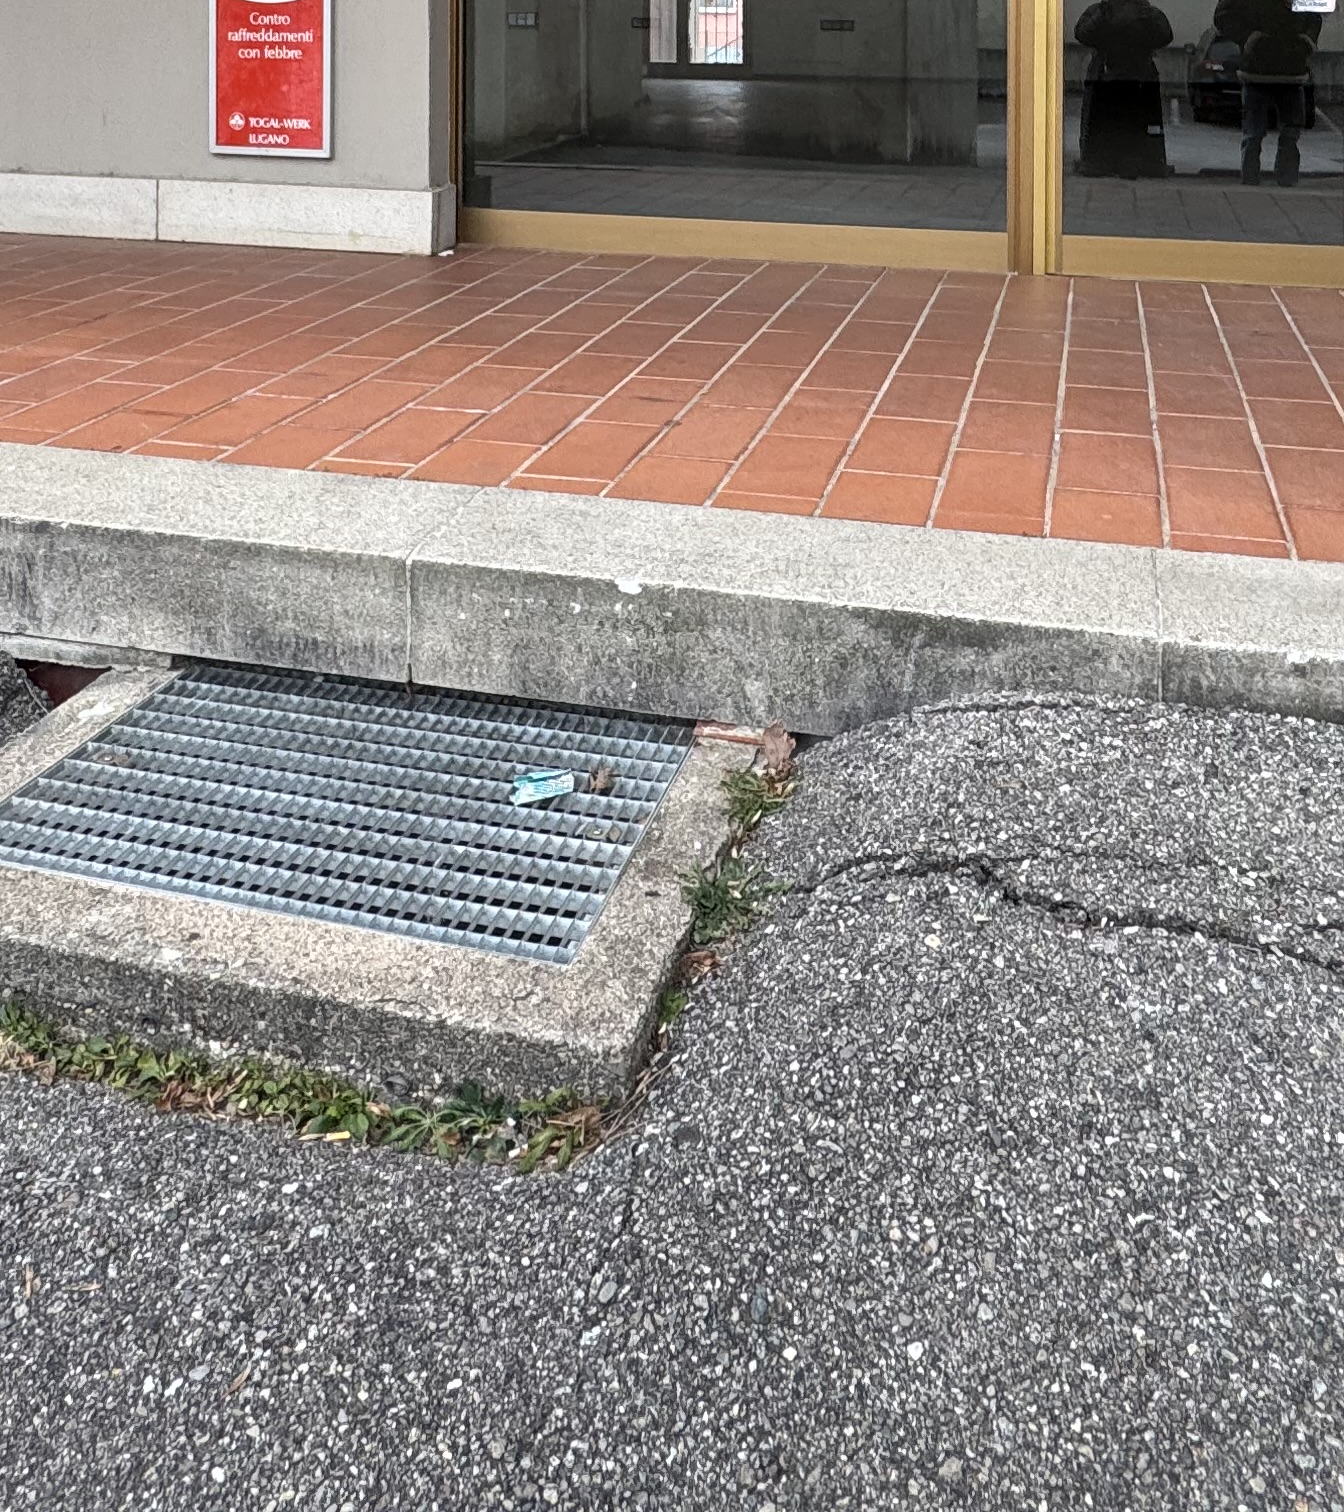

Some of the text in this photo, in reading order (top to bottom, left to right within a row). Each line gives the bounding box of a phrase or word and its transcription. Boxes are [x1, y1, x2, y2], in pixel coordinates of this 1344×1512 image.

[249, 12, 291, 25] Contro
[227, 28, 314, 43] raffreddamenti
[238, 45, 303, 59] con febbre
[248, 117, 311, 129] TOGAL-WERK
[248, 133, 290, 145] LUGANO
